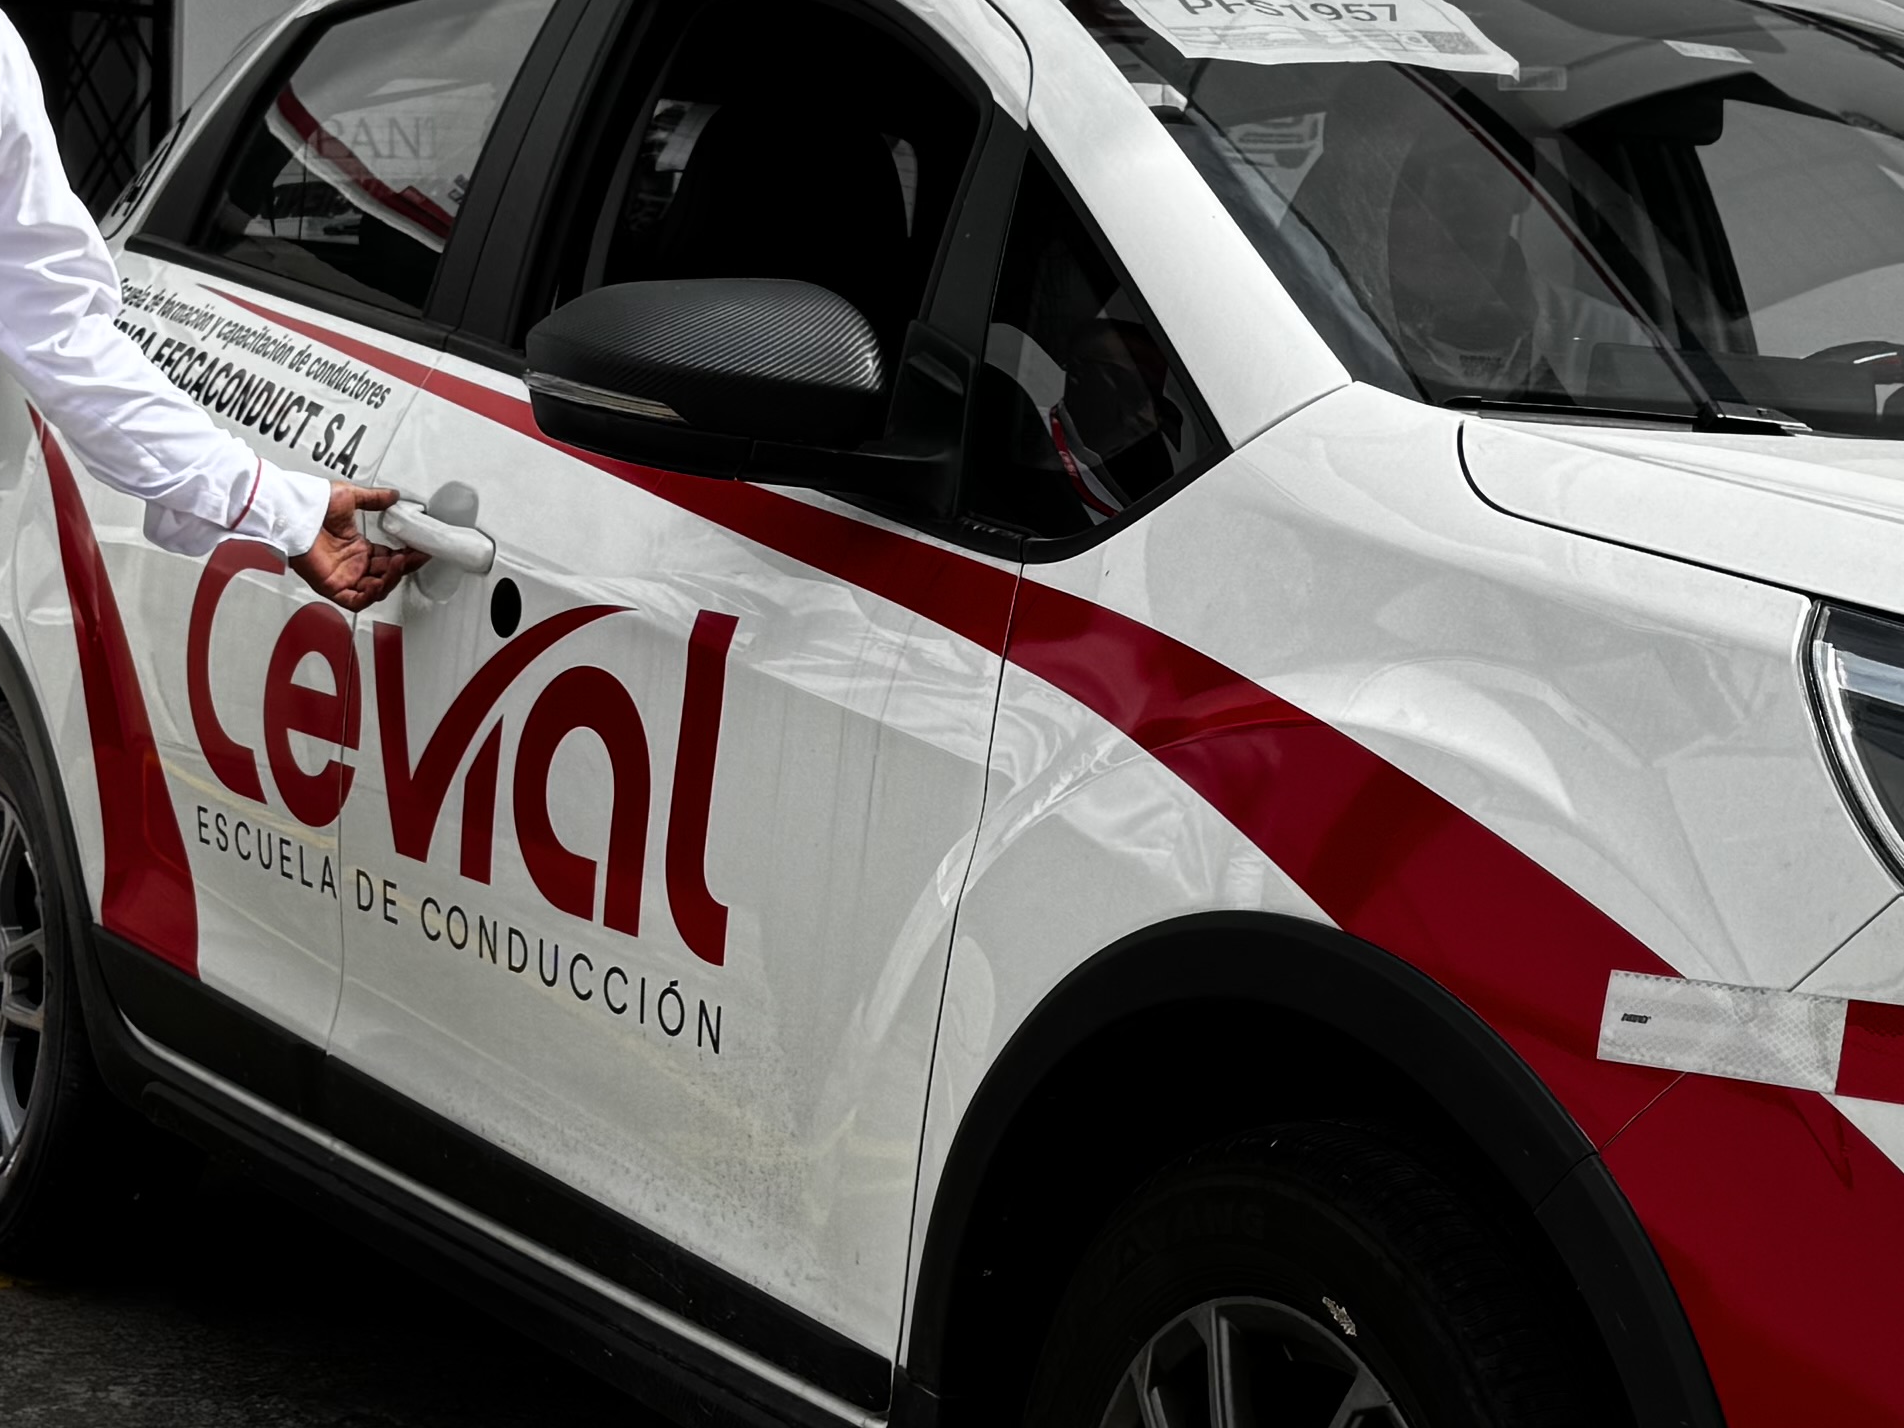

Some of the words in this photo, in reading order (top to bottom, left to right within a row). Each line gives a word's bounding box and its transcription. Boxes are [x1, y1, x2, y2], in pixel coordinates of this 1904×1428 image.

[157, 292, 215, 332] formación
[201, 315, 225, 341] y
[216, 318, 295, 367] capacitación
[288, 344, 313, 374] de
[305, 355, 392, 410] conductores
[312, 413, 368, 480] S.A.
[186, 539, 741, 967] Cevial
[197, 805, 337, 901] ESCUELA
[357, 868, 400, 927] DE
[420, 897, 723, 1055] CONDUCCIÓN
